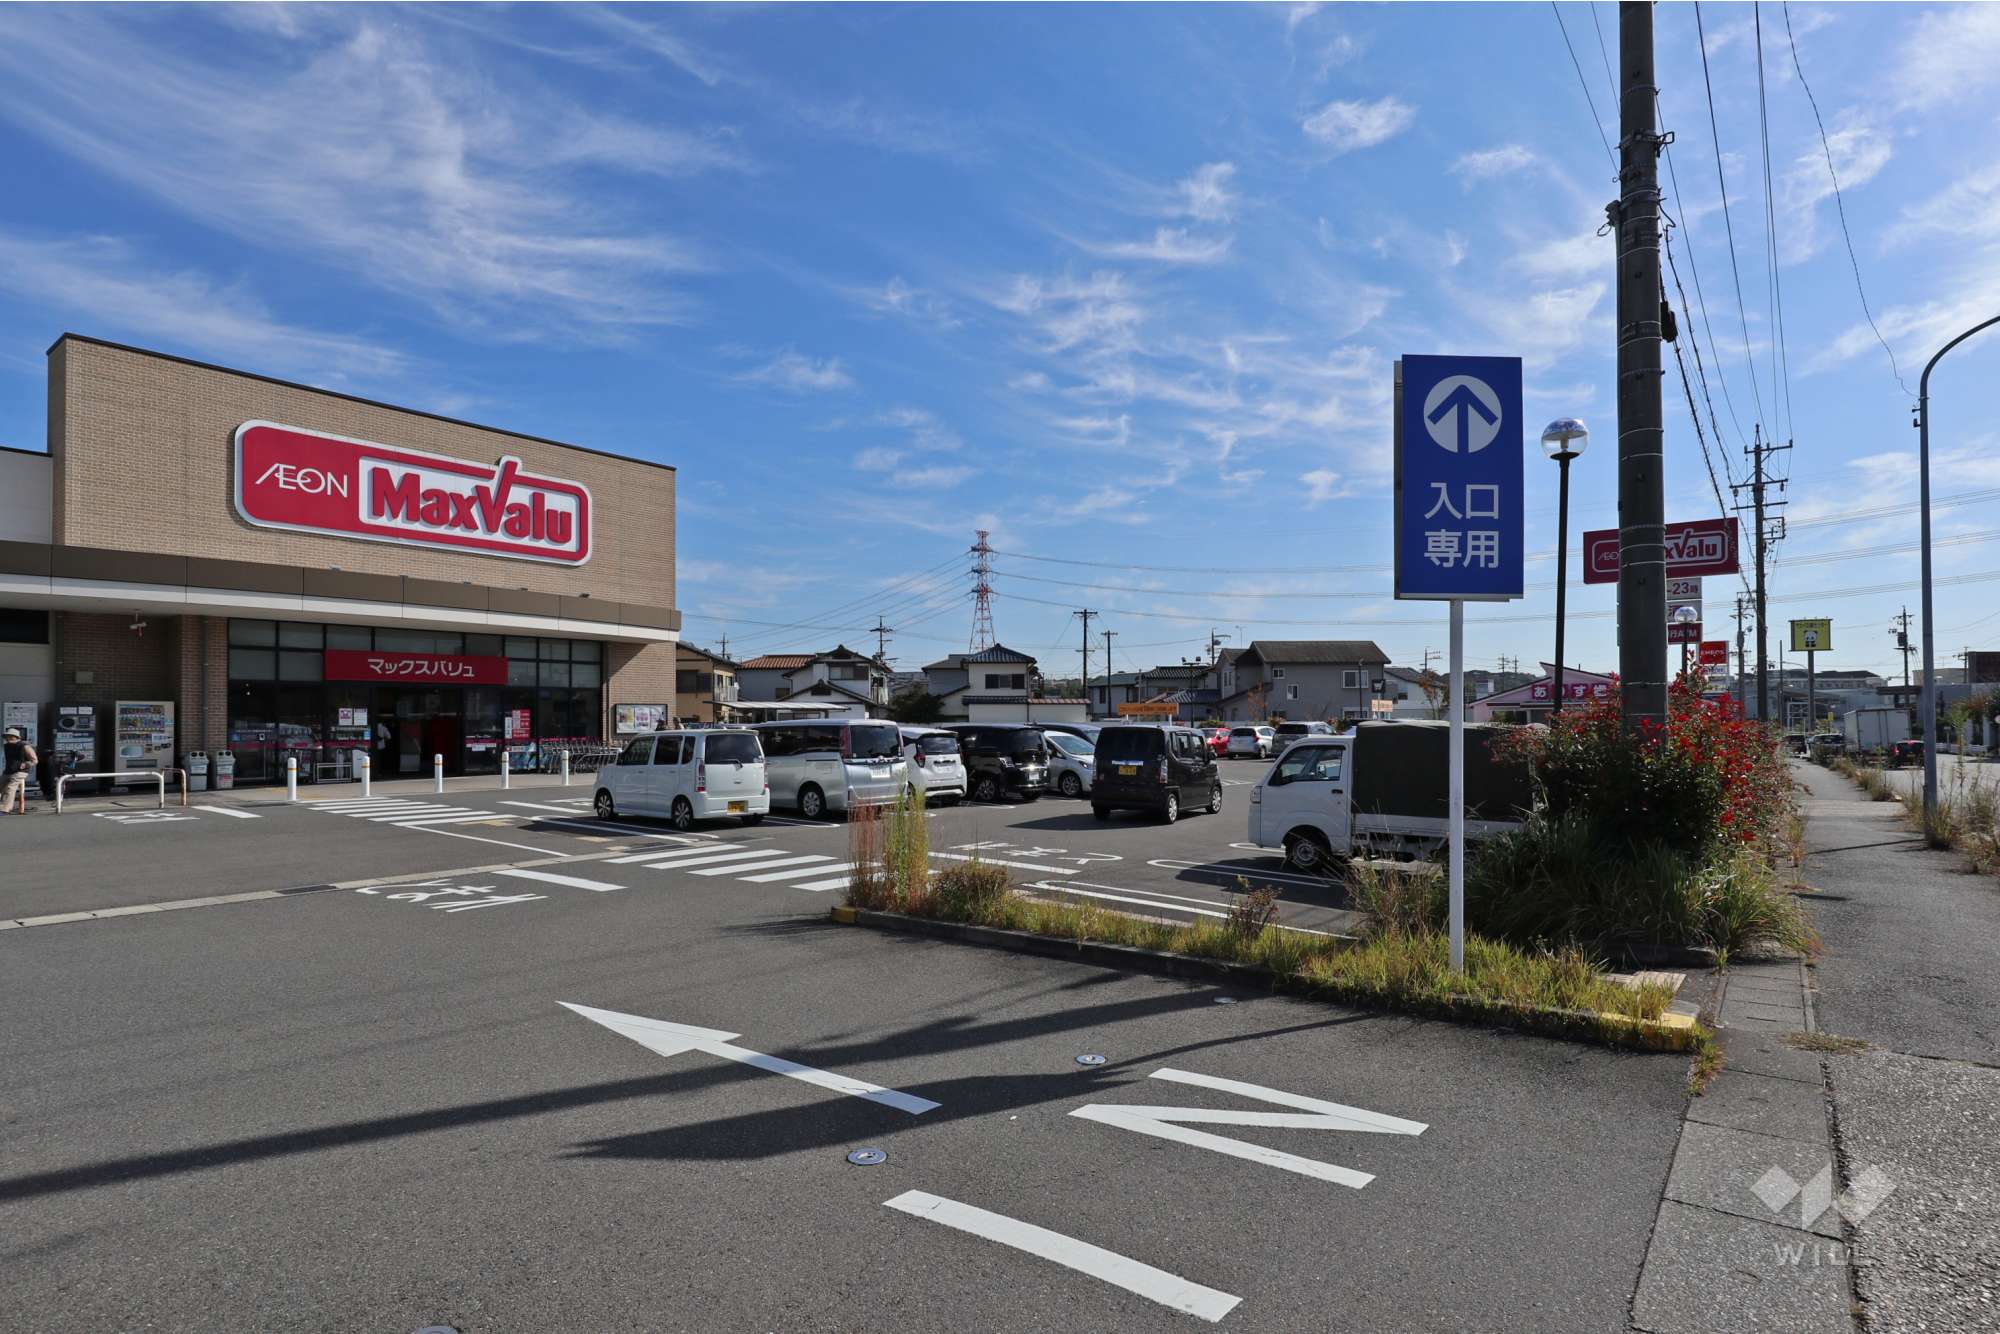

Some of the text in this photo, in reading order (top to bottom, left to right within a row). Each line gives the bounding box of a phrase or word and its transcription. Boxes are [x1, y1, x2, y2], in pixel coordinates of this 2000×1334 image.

[369, 460, 572, 544] MaxValu
[1424, 482, 1499, 520] 入口
[1424, 529, 1499, 568] 専用
[367, 658, 475, 678] マックスバリュ
